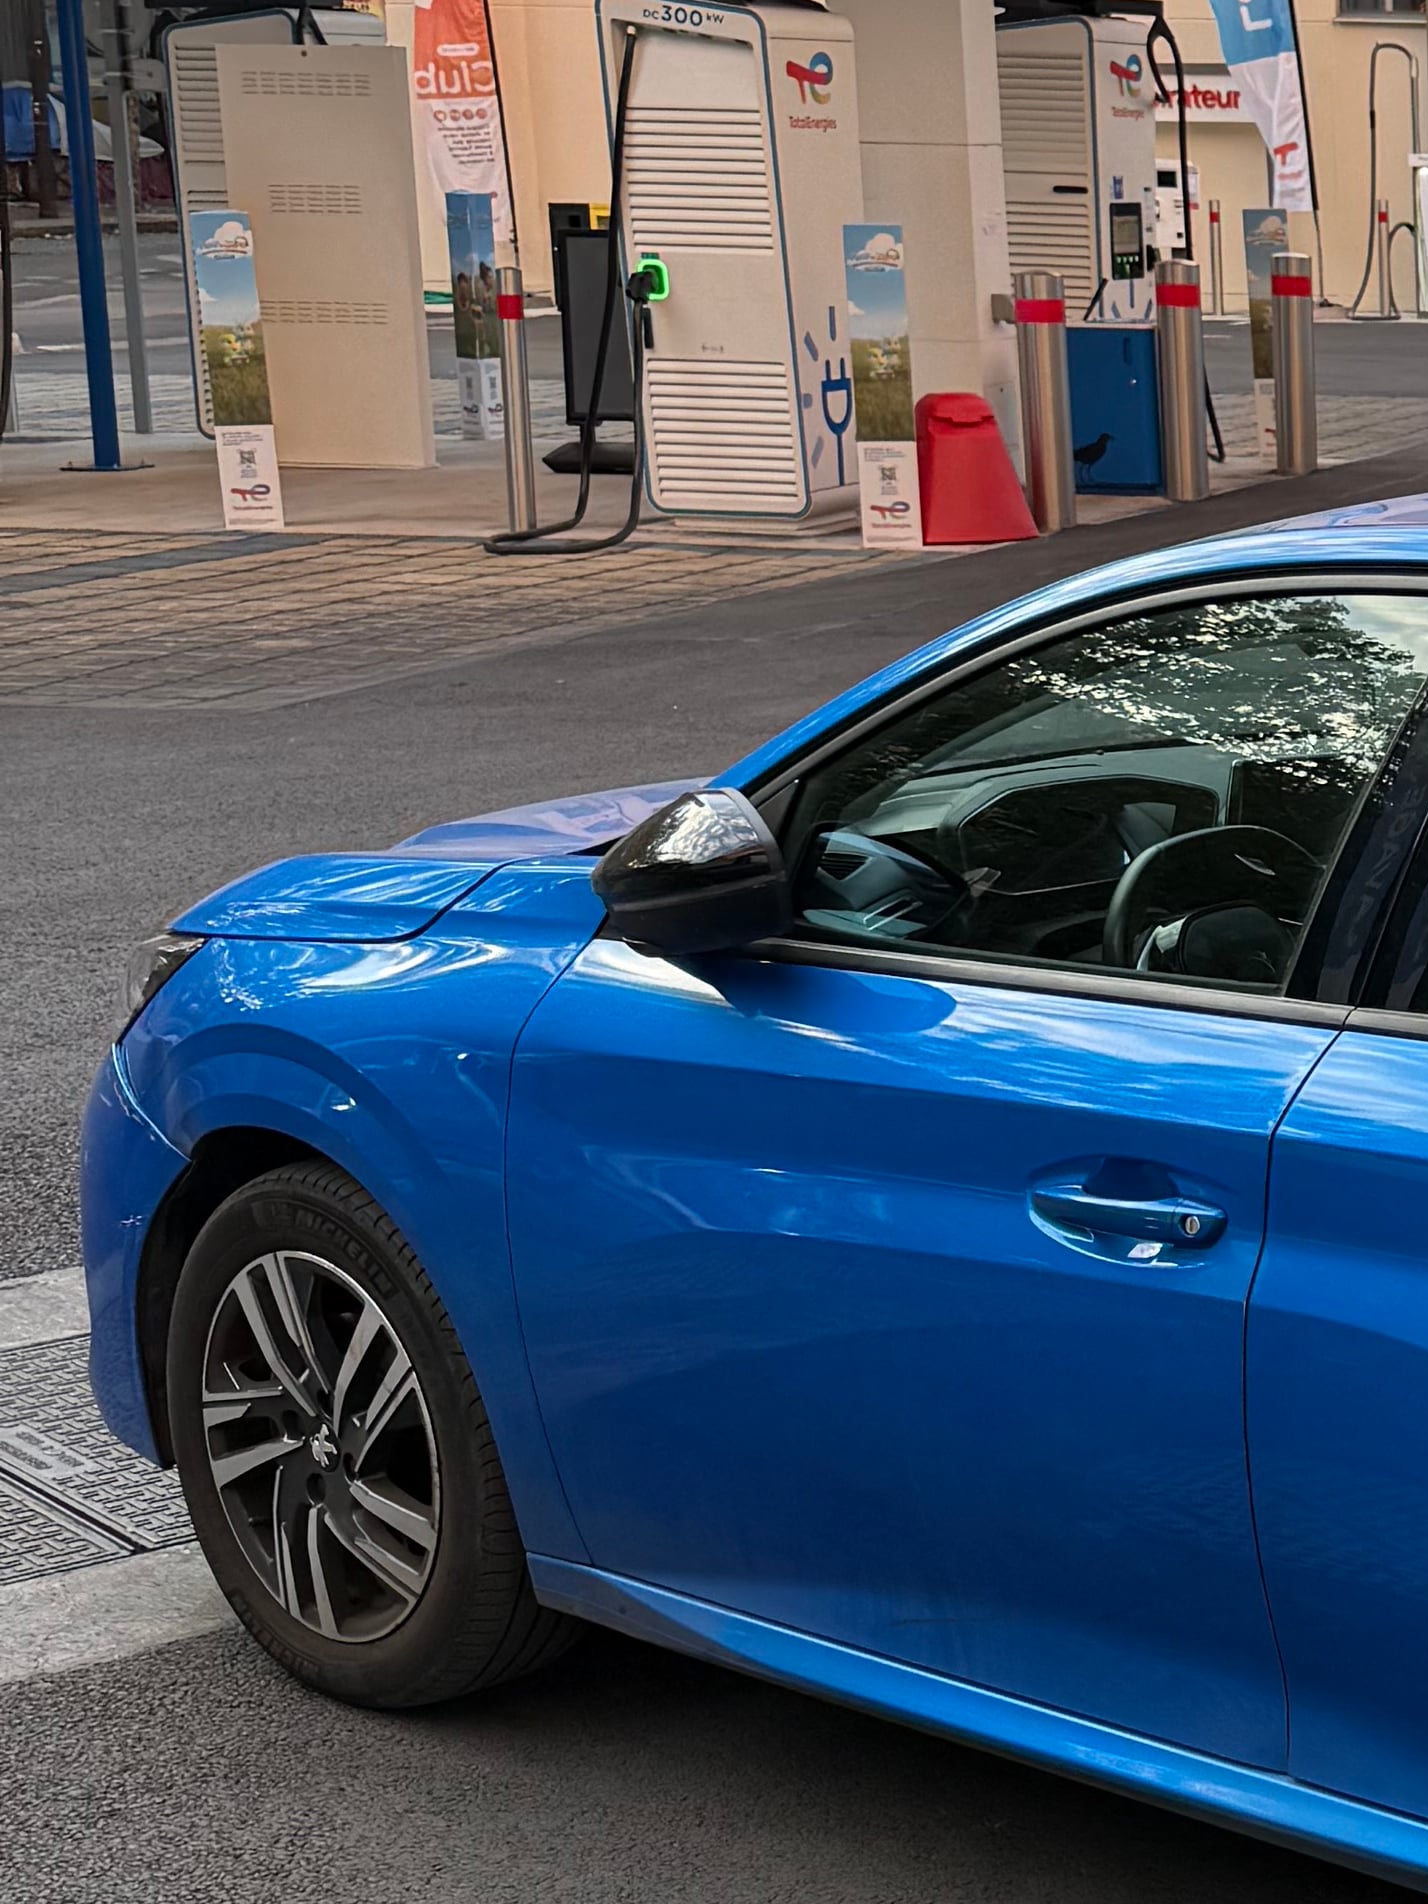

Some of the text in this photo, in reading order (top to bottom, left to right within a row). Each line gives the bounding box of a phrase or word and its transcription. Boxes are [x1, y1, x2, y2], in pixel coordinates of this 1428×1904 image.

[643, 5, 725, 27] DC 300 kW
[789, 116, 837, 132] TotalEnergies
